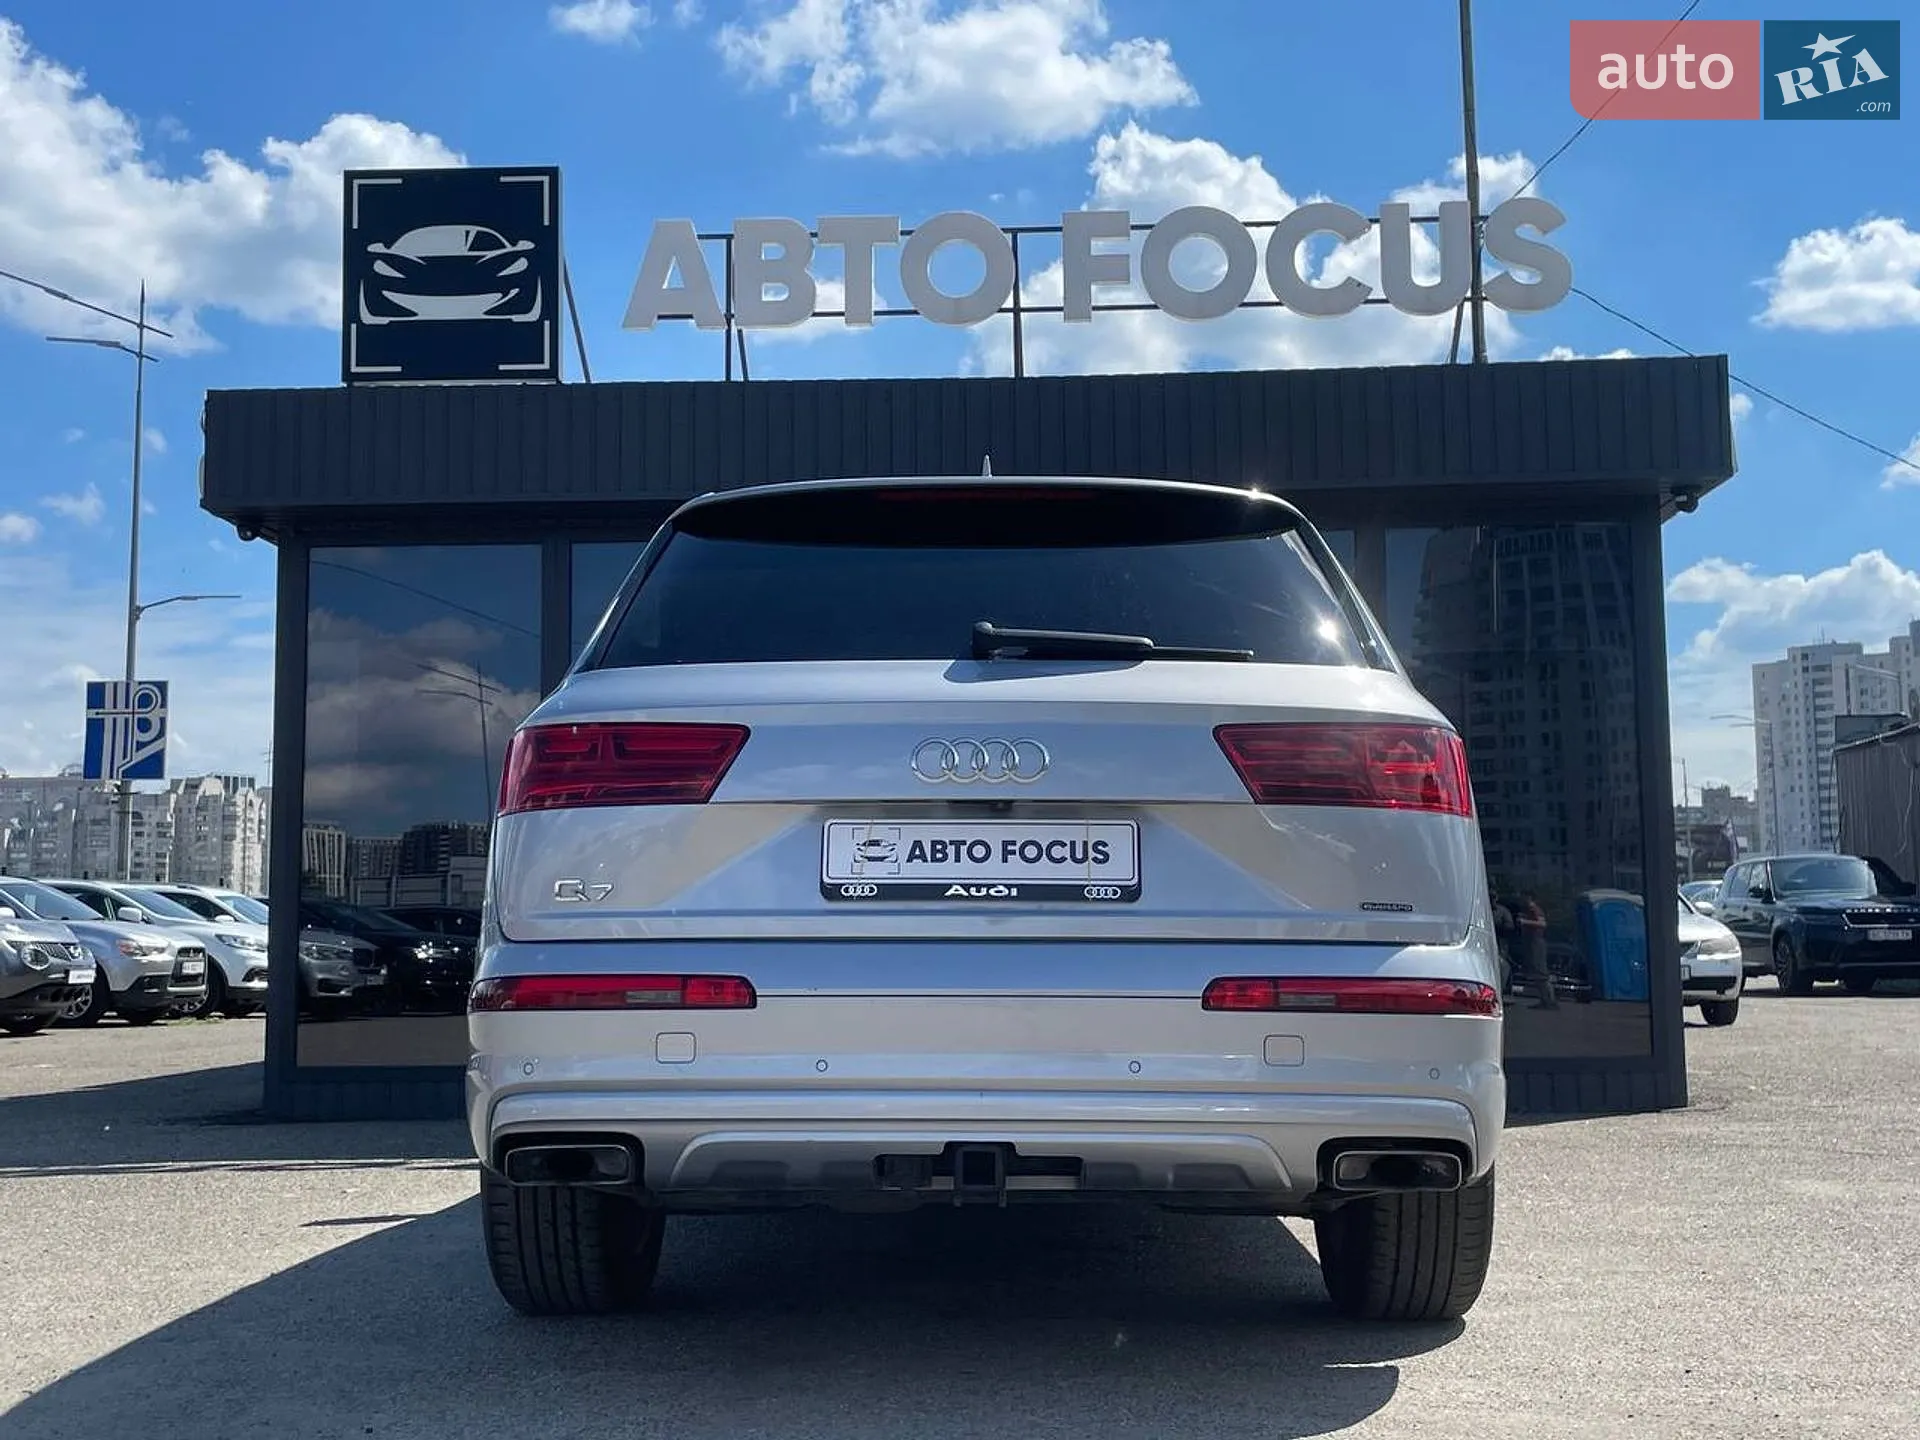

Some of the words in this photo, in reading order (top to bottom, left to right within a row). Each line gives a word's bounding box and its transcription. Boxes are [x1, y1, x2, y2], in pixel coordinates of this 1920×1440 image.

[622, 210, 1015, 330] АВТО
[1061, 198, 1574, 324] FOCUS
[906, 839, 993, 864] АВТО
[1001, 839, 1111, 865] FOCUS
[554, 878, 615, 902] Q7
[943, 884, 1018, 898] Audi
